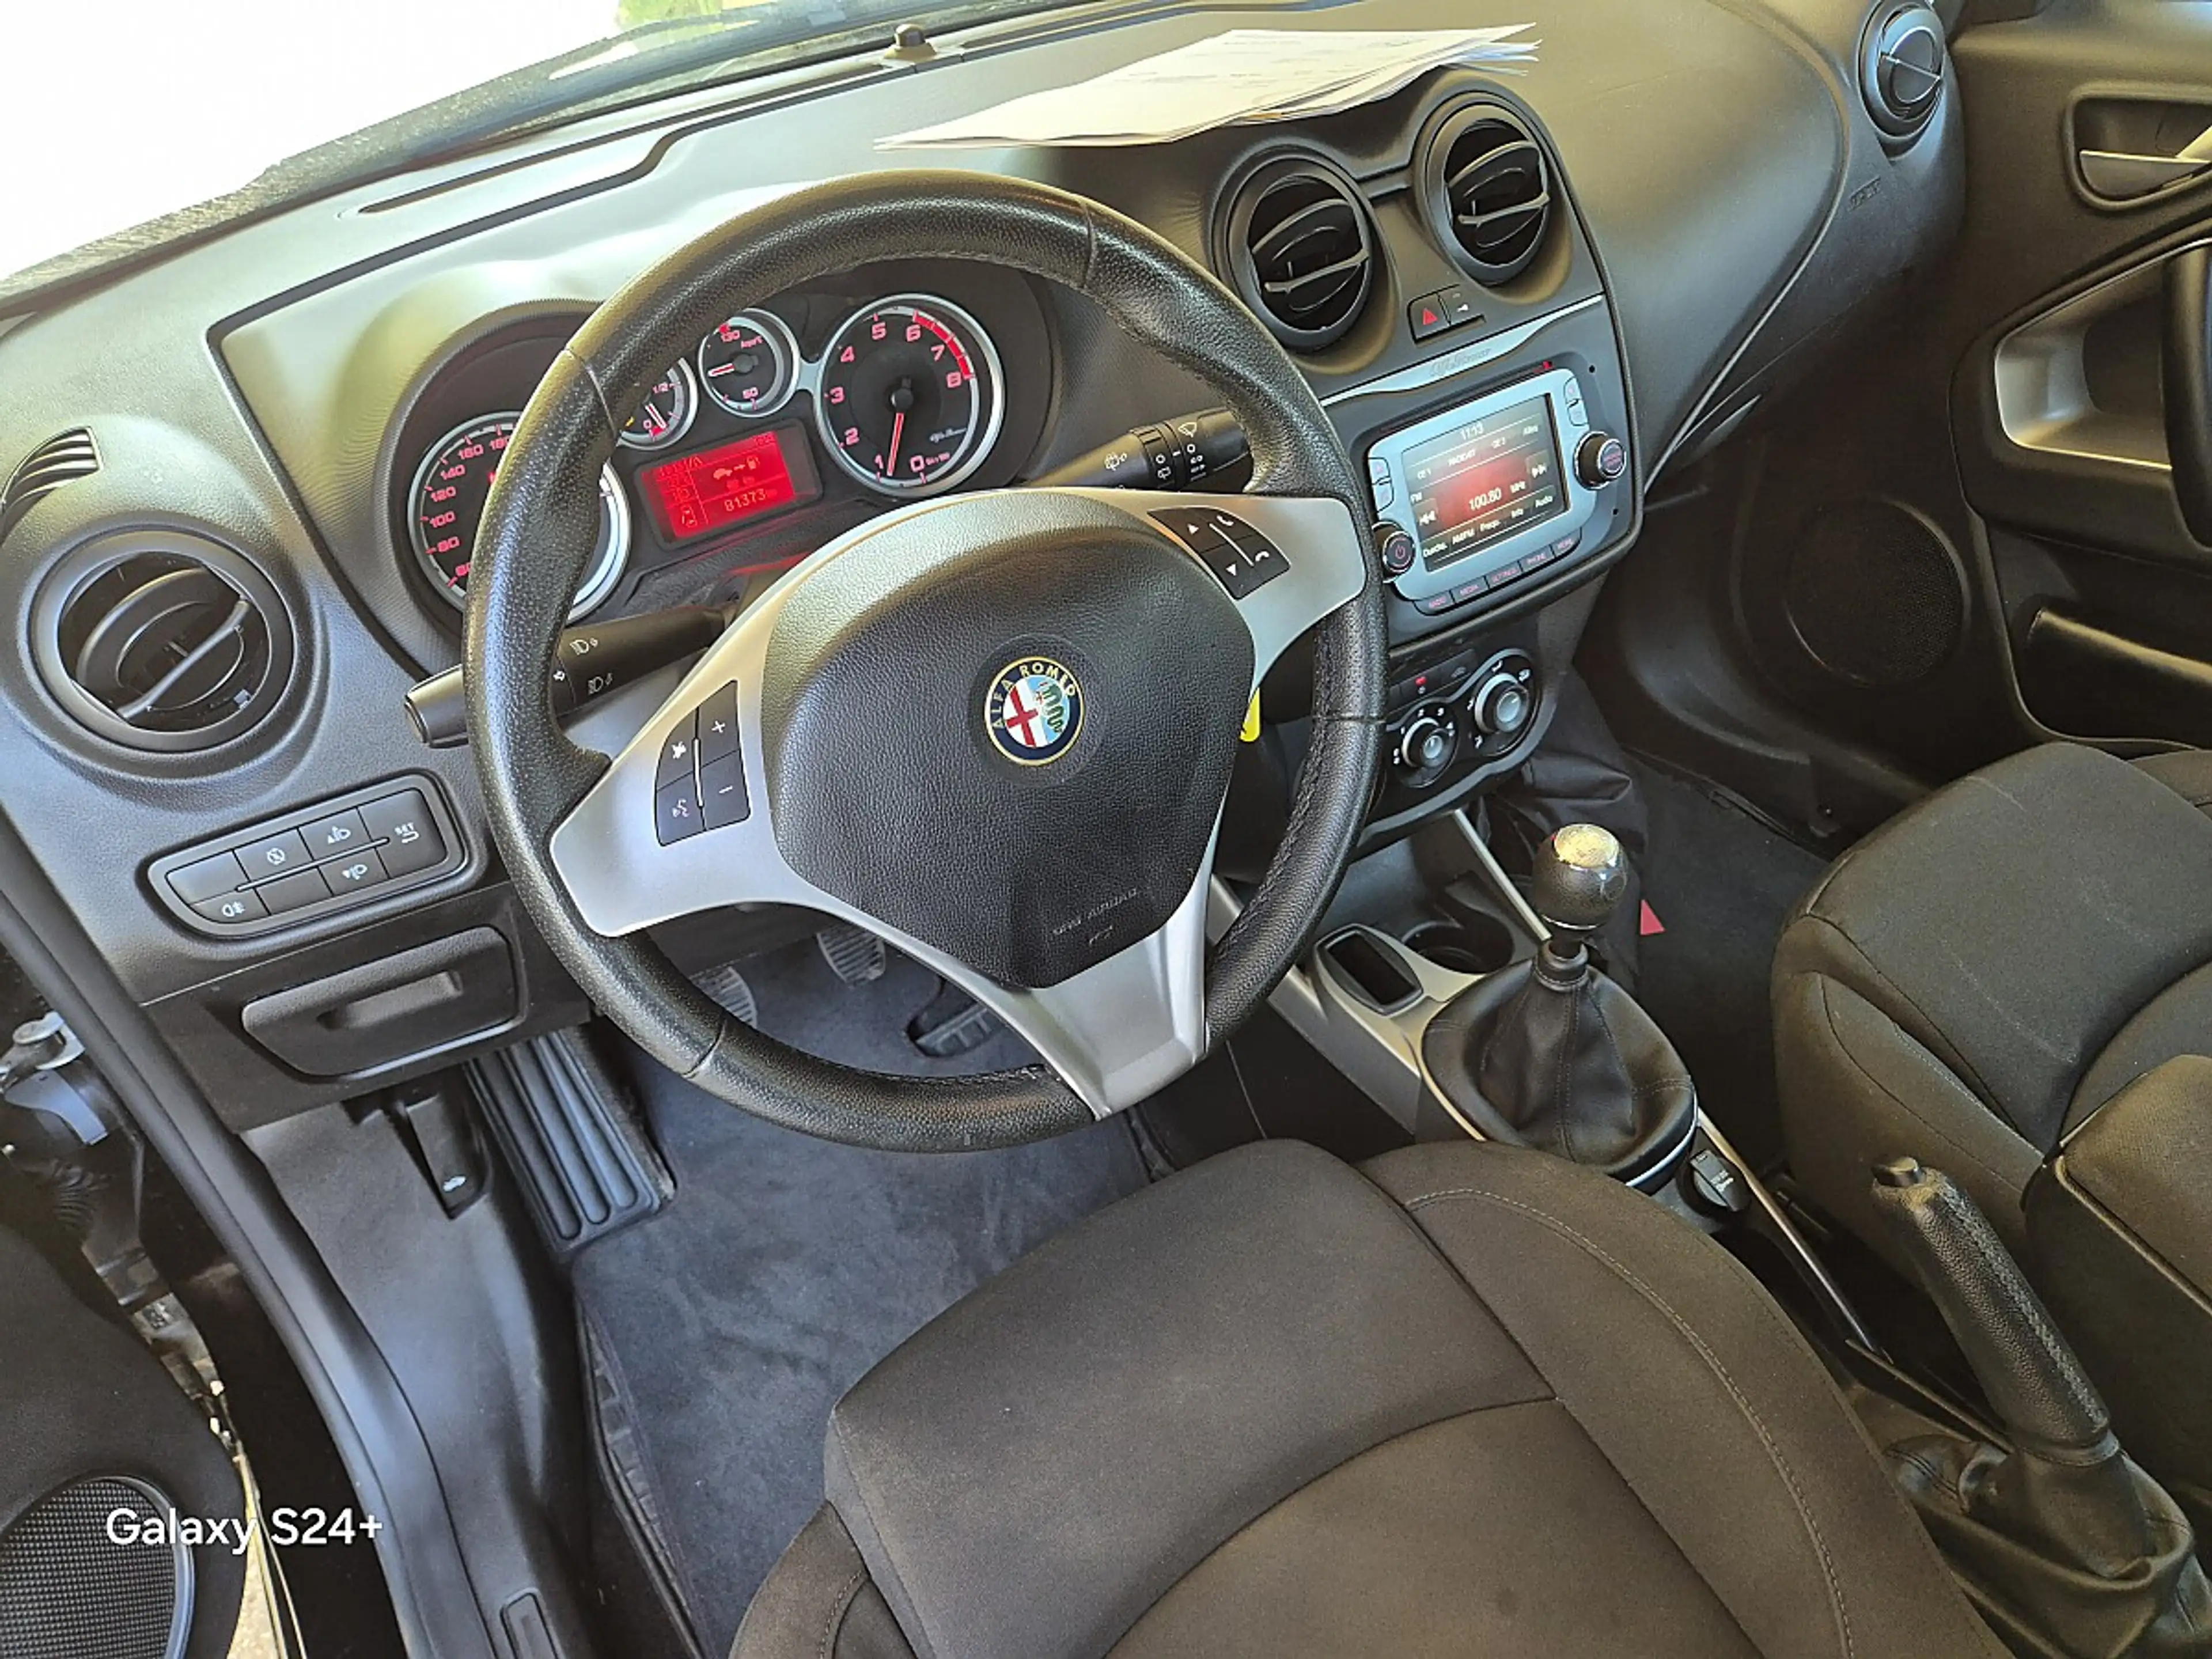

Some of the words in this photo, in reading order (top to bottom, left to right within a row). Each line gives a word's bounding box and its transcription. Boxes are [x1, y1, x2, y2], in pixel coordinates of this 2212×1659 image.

[872, 322, 887, 339] 5
[906, 324, 921, 342] 6
[840, 346, 855, 362] 4
[931, 344, 945, 361] 7
[946, 372, 961, 388] 8
[830, 387, 845, 403] 3
[844, 427, 859, 445] 2
[874, 454, 884, 469] 1
[910, 455, 925, 472] 0
[441, 464, 465, 480] 140
[431, 486, 456, 502] 120
[724, 488, 766, 512] 81373
[1469, 488, 1502, 510] 100.80
[430, 511, 456, 528] 100
[437, 536, 460, 552] 80
[1019, 662, 1075, 696] ROMEO
[991, 679, 1013, 729] ALFA
